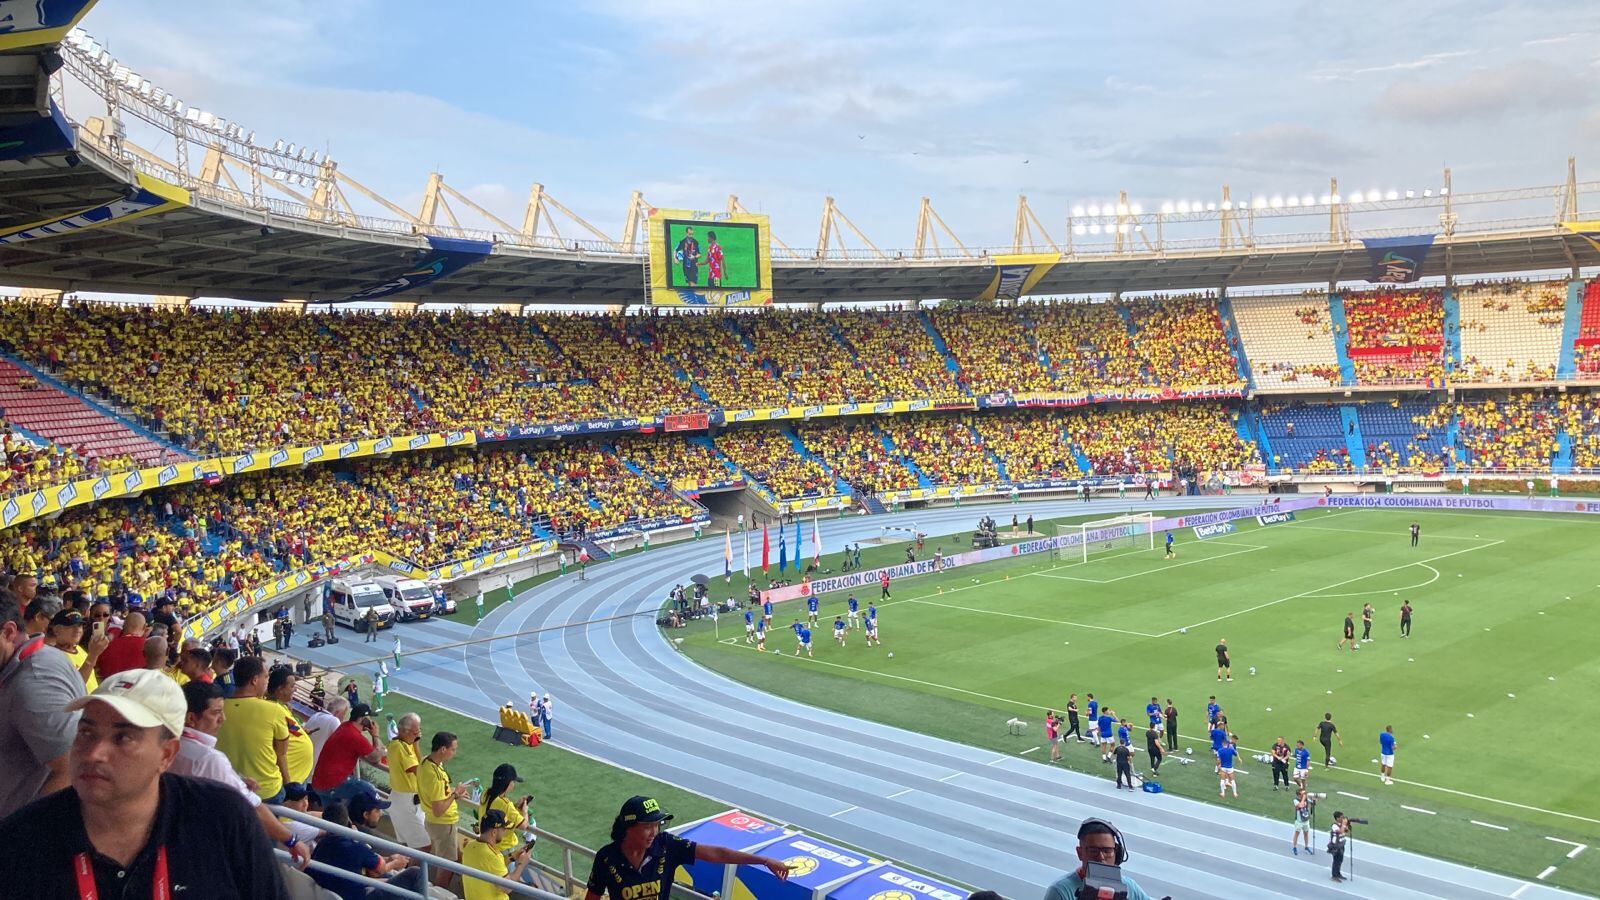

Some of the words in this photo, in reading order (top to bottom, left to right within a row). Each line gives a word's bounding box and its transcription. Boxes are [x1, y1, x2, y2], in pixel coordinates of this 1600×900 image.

[553, 424, 576, 432] BetPlay
[588, 421, 610, 429] BetPlay
[1384, 497, 1443, 507] COLOMBIANA
[1446, 498, 1457, 507] DE
[1587, 503, 1600, 512] FE
[1219, 508, 1254, 521] COLOMBIANA
[1264, 513, 1287, 524] BetPlay
[1198, 522, 1226, 537] BetPlay
[917, 562, 927, 573] DE
[928, 557, 956, 571] FBOL
[621, 879, 661, 900] OPEN
